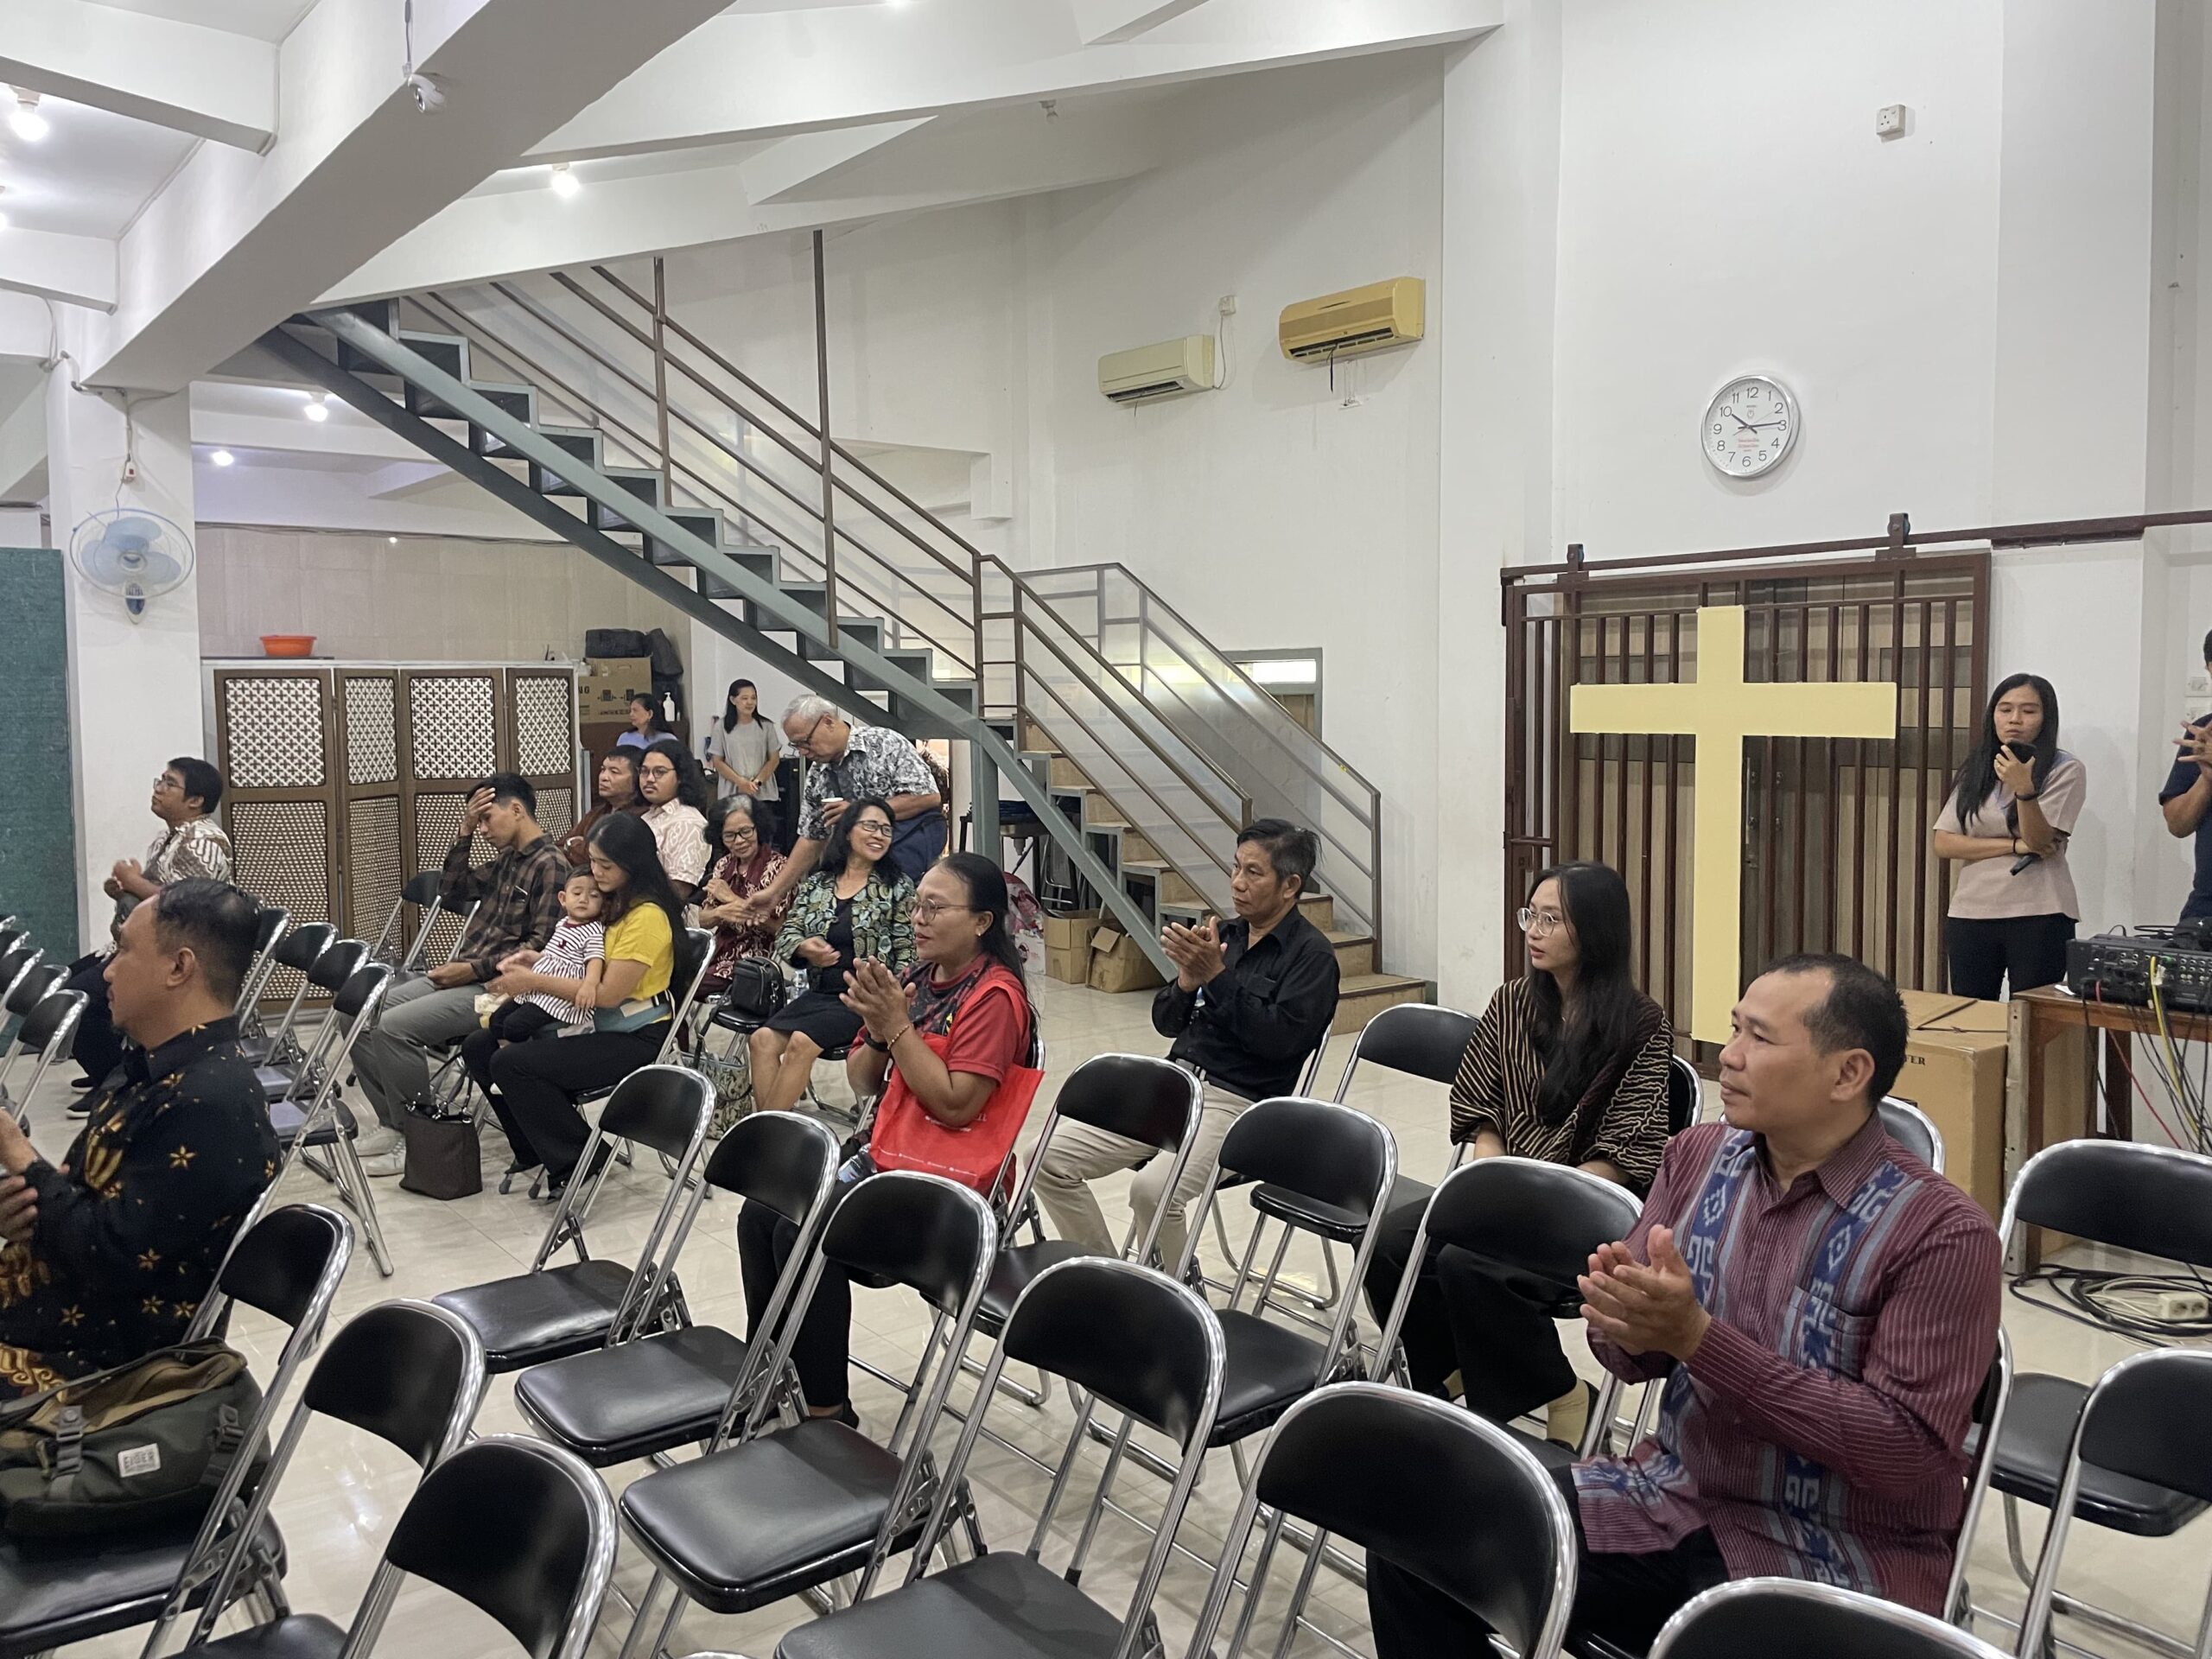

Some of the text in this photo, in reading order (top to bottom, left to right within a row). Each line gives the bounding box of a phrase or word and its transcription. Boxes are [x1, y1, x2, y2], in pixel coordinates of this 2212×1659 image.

[1746, 386, 1759, 398] 12
[1768, 391, 1772, 401] 1
[1732, 392, 1739, 404] 11
[1720, 405, 1732, 417] 10
[1775, 403, 1783, 414] 2
[1713, 423, 1722, 435] 9
[1777, 419, 1787, 431] 3
[1717, 440, 1726, 451] 8
[1771, 437, 1780, 448] 4
[1728, 451, 1736, 462] 7
[1758, 450, 1767, 461] 5
[1742, 456, 1751, 467] 6
